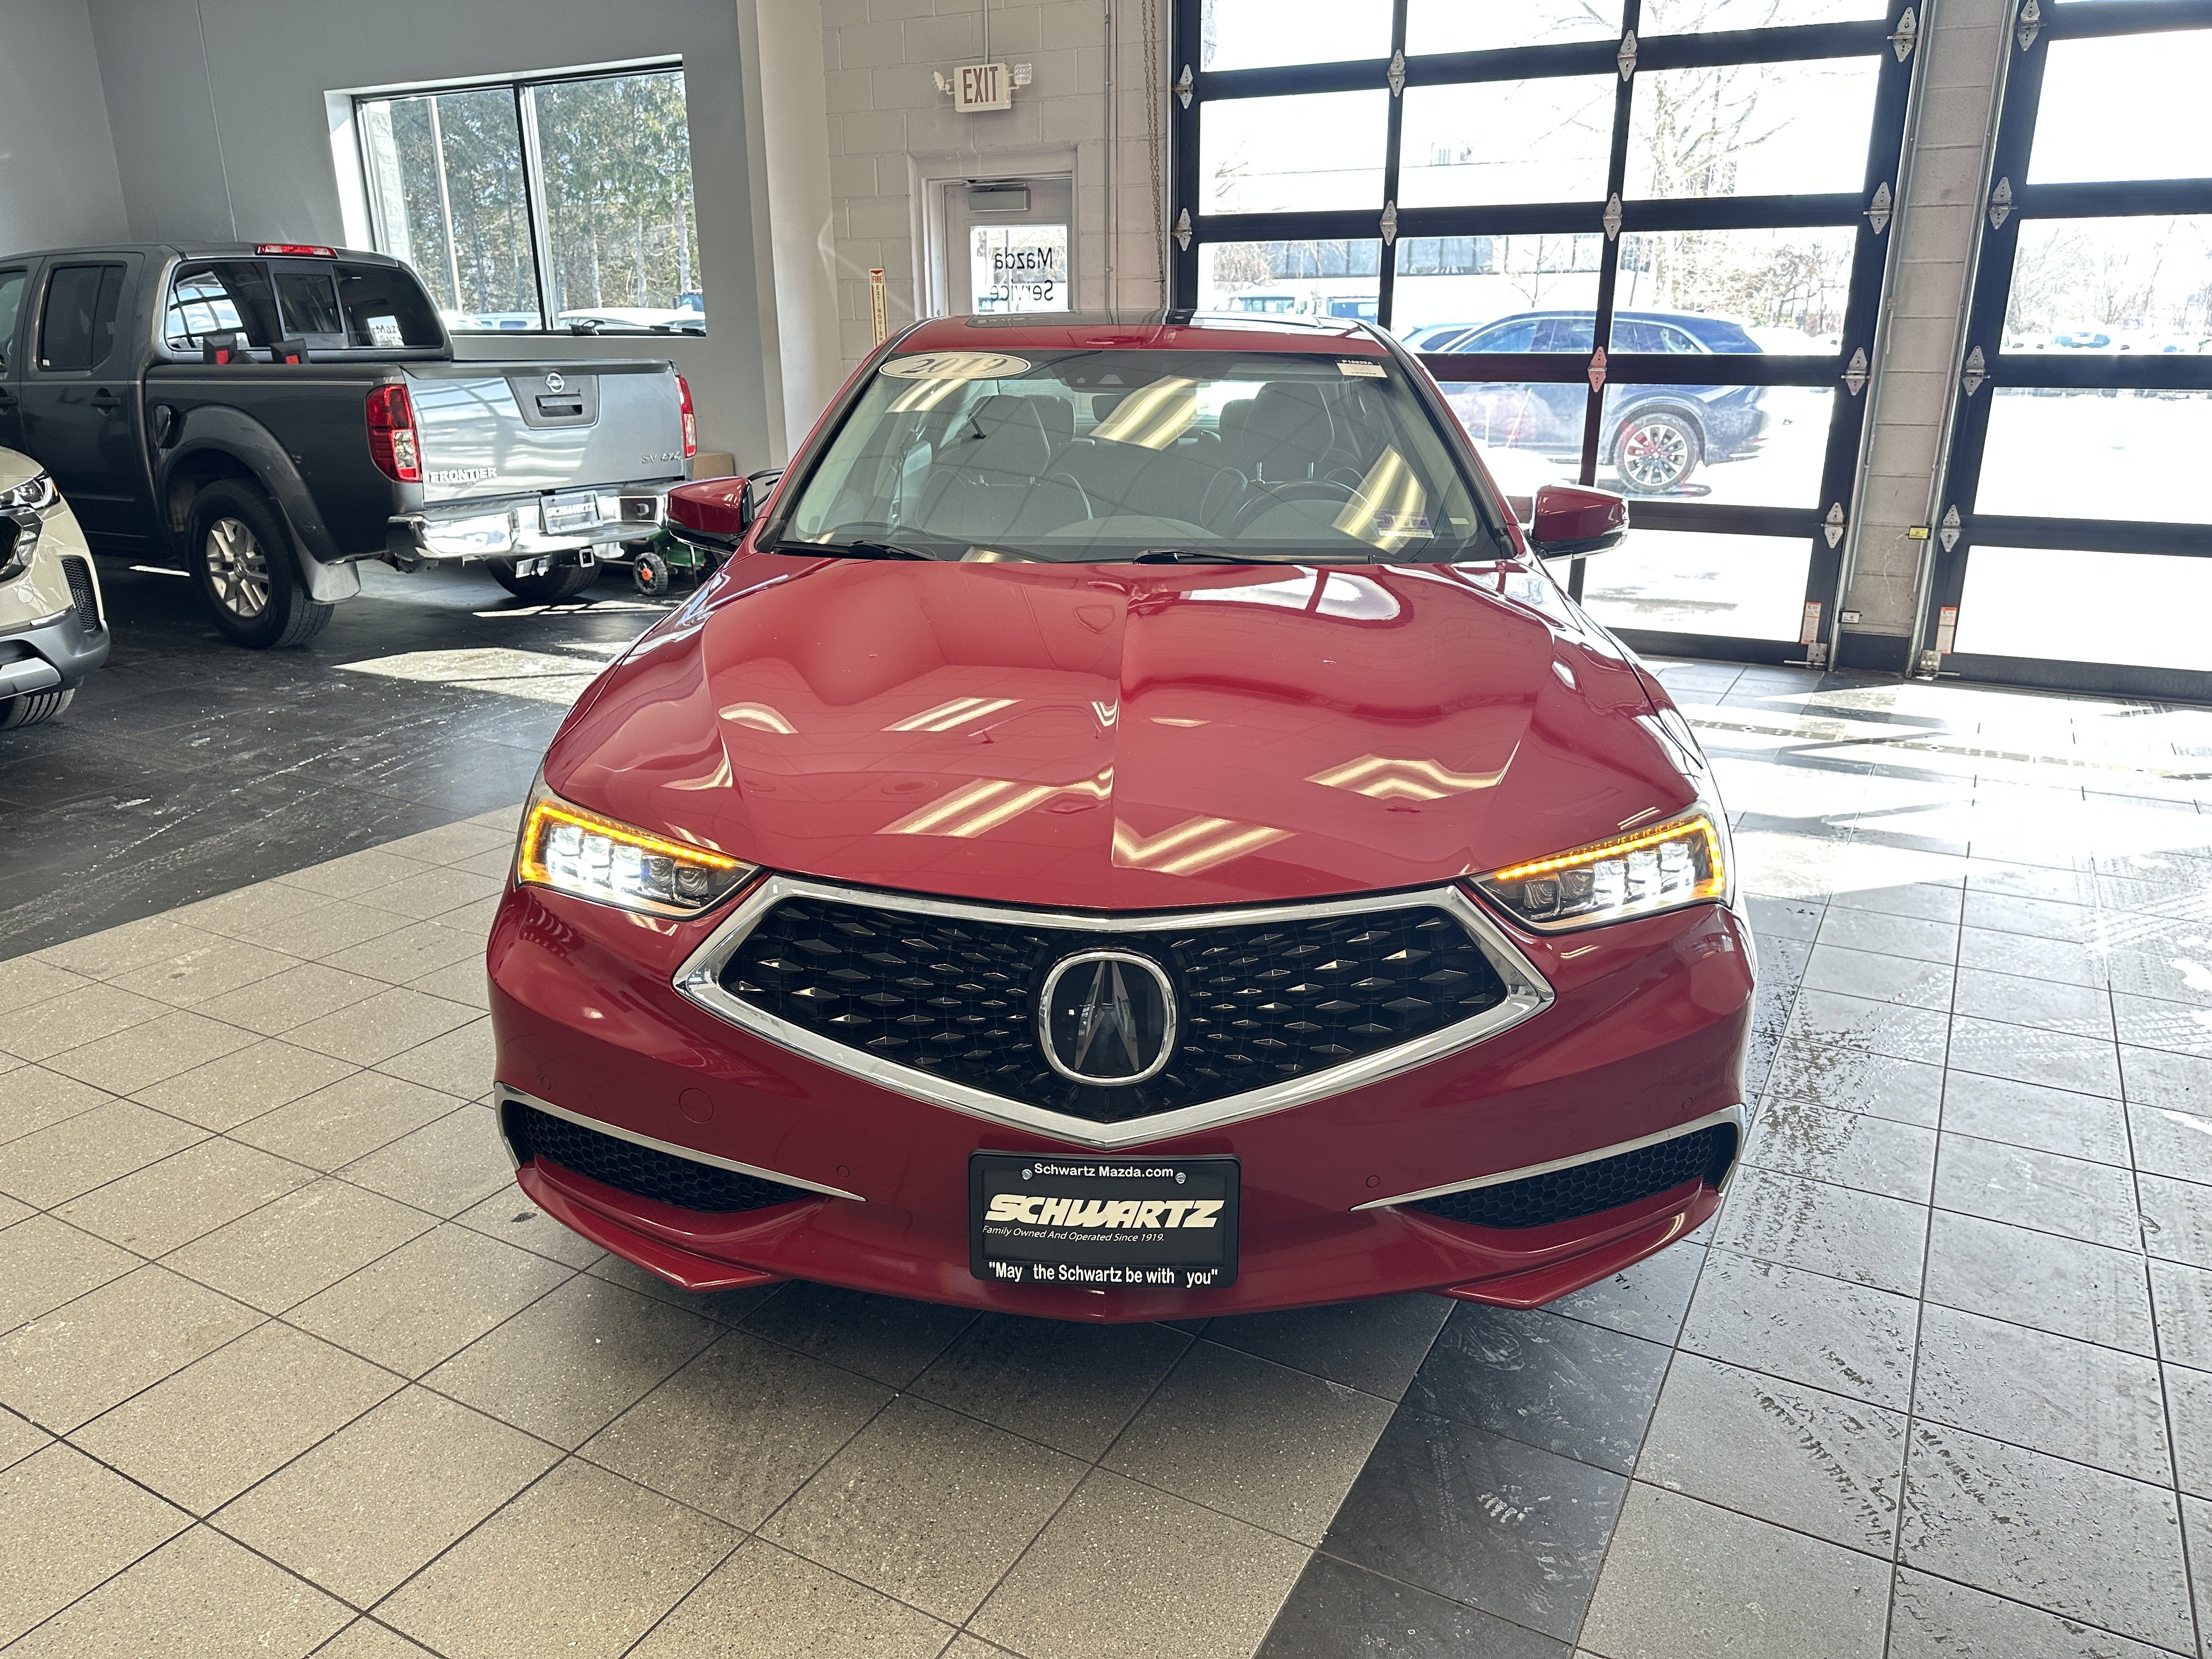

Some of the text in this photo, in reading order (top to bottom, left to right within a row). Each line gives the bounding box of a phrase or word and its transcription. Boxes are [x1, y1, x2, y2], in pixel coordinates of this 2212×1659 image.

[963, 66, 998, 104] EXIT
[872, 275, 883, 284] FIRE
[899, 358, 1008, 374] 2019
[641, 454, 657, 464] SV
[429, 467, 498, 482] FRONTIER
[546, 501, 596, 517] SCHWARTZ
[1034, 1163, 1173, 1177] Schwartz Mazda.com
[985, 1194, 1225, 1228] SCHWARTZ
[983, 1226, 1165, 1242] Family Owned And Operated Since 1919.
[989, 1261, 1218, 1288] "May the Schwartz be with you"
